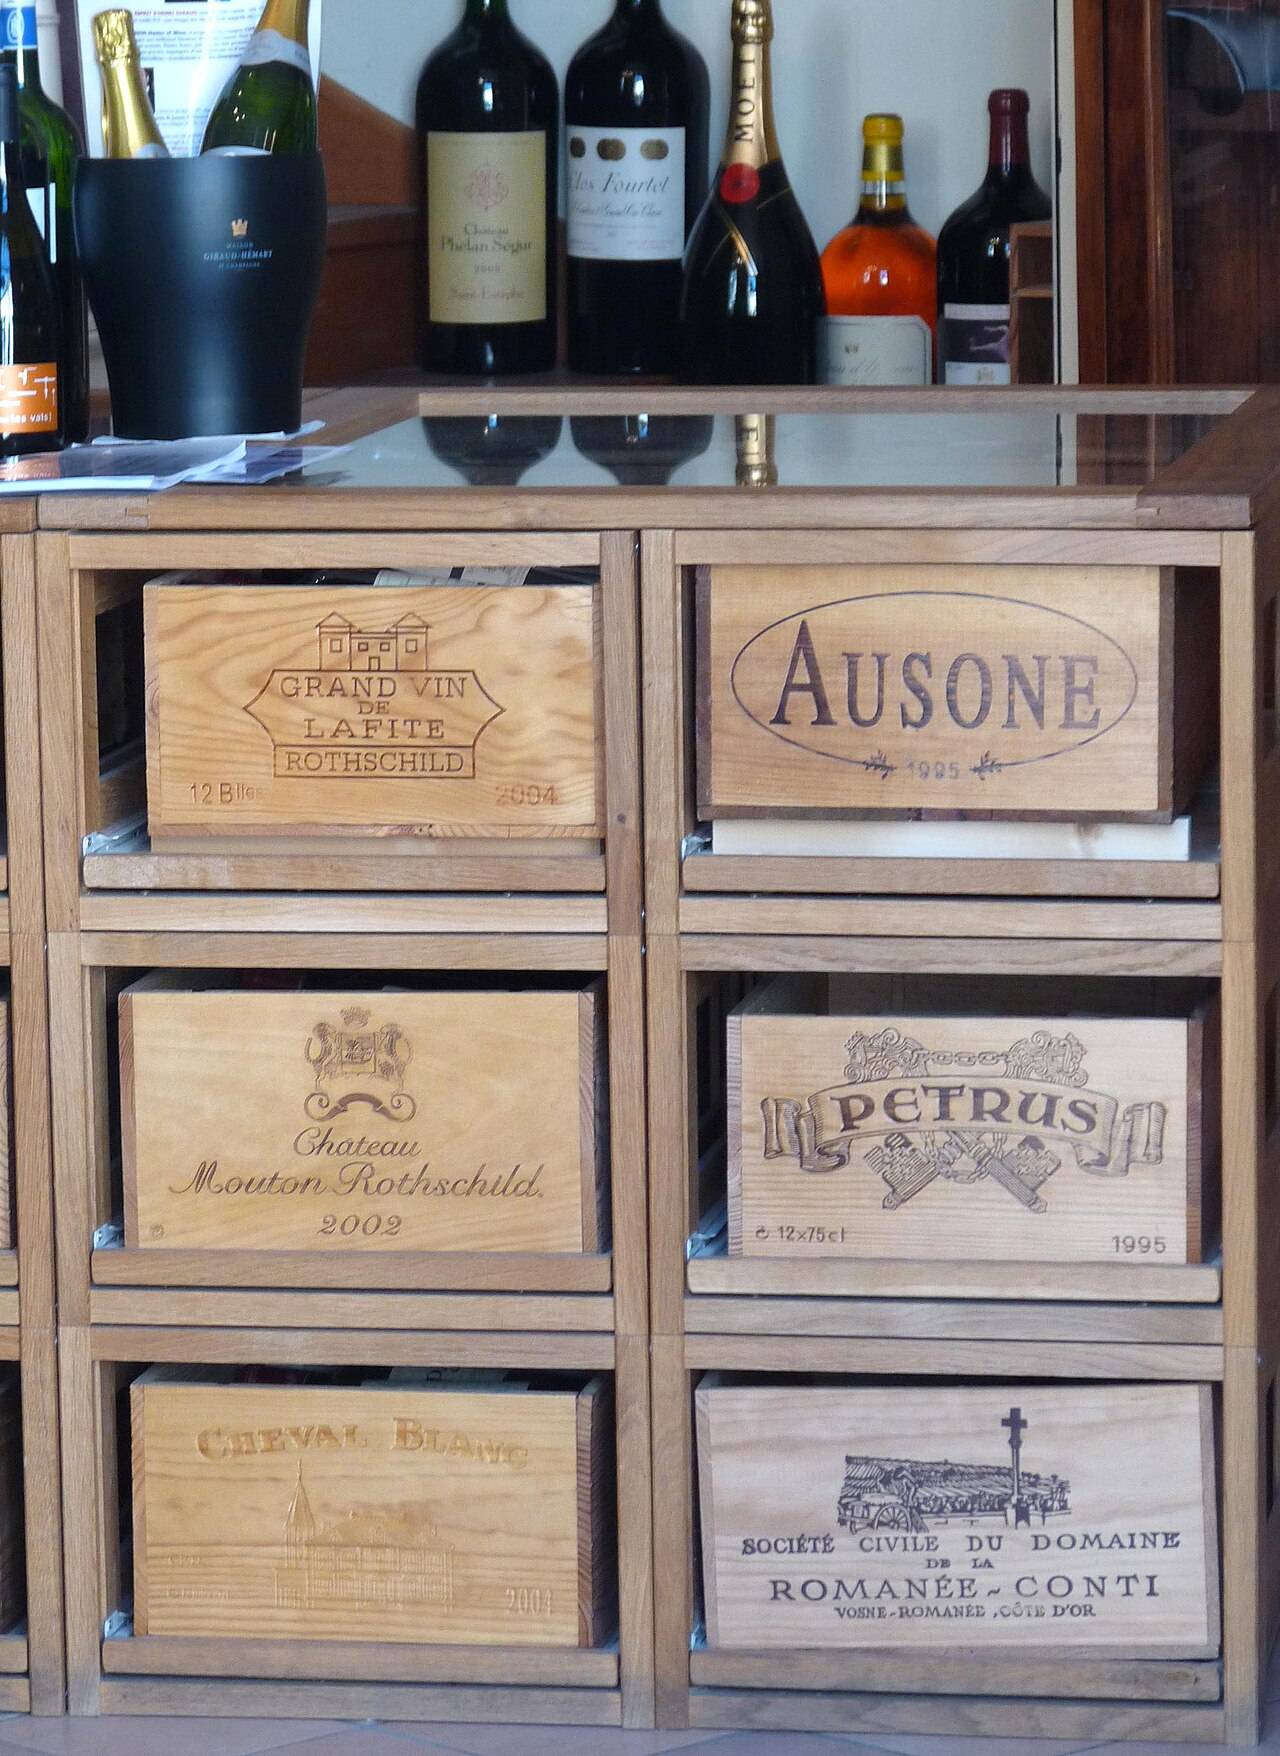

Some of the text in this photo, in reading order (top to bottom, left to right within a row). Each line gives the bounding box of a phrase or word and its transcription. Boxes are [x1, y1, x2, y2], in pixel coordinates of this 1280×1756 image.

[602, 171, 670, 193] Fourtet
[769, 618, 1101, 730] AUSONE
[280, 676, 467, 698] GRAND VIN
[358, 701, 389, 714] DE
[304, 718, 445, 739] LAFITE
[286, 751, 464, 773] ROTHSCHILD
[905, 761, 960, 780] 1995
[188, 782, 212, 804] 12
[495, 785, 559, 805] 2004
[831, 1085, 1097, 1134] PETRUS
[169, 1160, 327, 1197] Mouton
[317, 1214, 402, 1236] 2002
[1112, 1236, 1167, 1254] 1995
[196, 1417, 527, 1470] CHEVAL BLANC
[742, 1532, 1181, 1555] SOCIÉTÉ CIVILE DU DOMAINE
[926, 1558, 995, 1569] DE LA
[1052, 1604, 1096, 1617] D'OR
